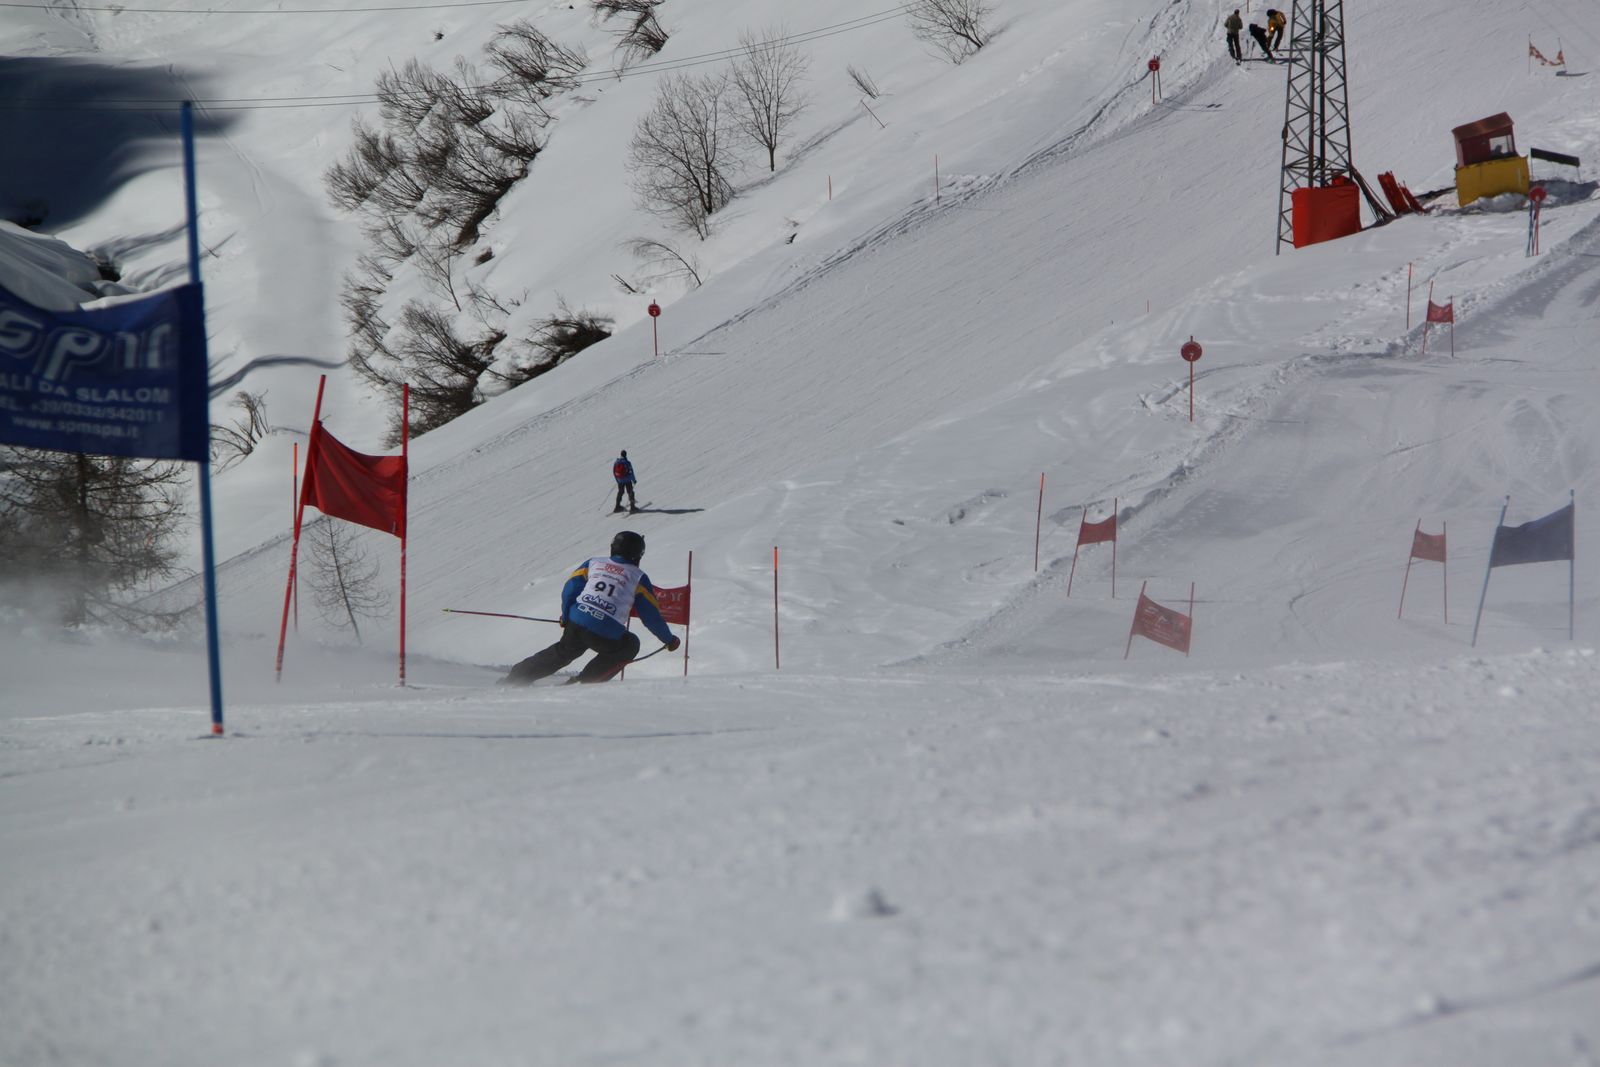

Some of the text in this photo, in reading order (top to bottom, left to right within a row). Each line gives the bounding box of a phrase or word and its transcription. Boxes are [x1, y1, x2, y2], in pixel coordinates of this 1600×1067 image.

[38, 380, 69, 397] DA
[75, 386, 170, 405] SLALOM
[12, 414, 140, 439] www.spmspa.it
[595, 581, 616, 597] 91
